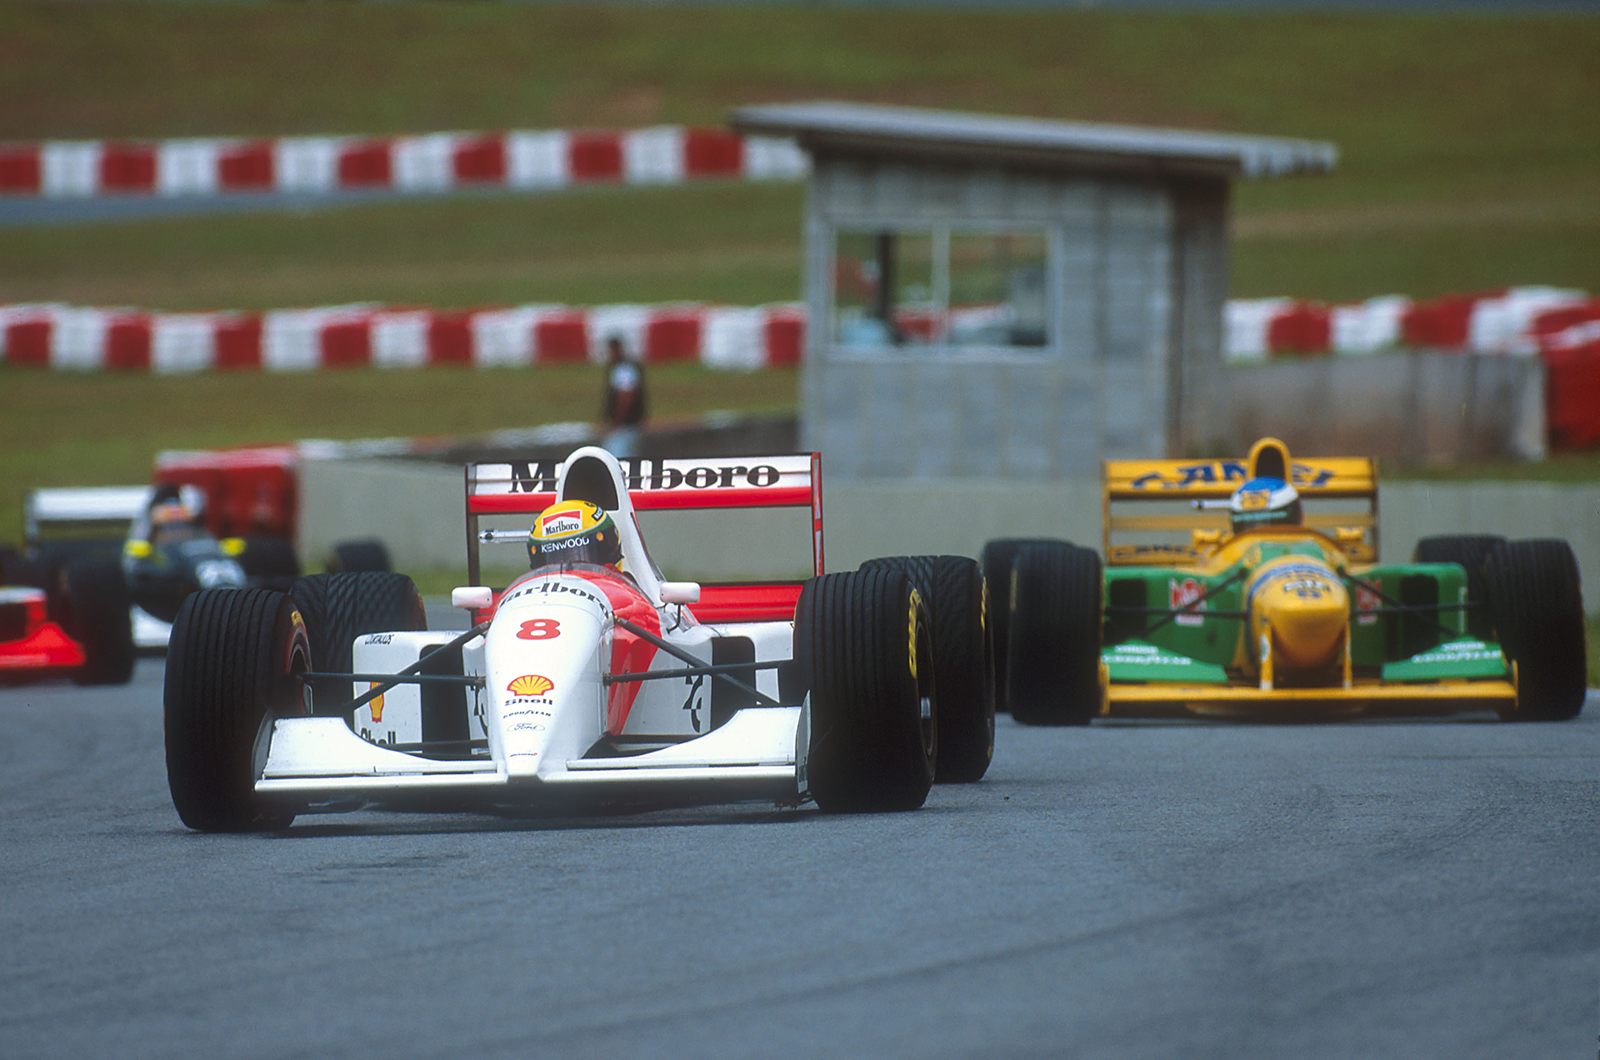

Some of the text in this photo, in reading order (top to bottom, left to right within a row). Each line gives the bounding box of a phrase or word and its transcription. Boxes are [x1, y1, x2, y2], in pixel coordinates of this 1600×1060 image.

[508, 457, 781, 493] Mlboro
[545, 520, 579, 536] Marlboro
[541, 536, 590, 553] KENWOOD
[516, 618, 561, 641] 8
[504, 698, 553, 706] Shell
[503, 709, 552, 719] GOODYEAR
